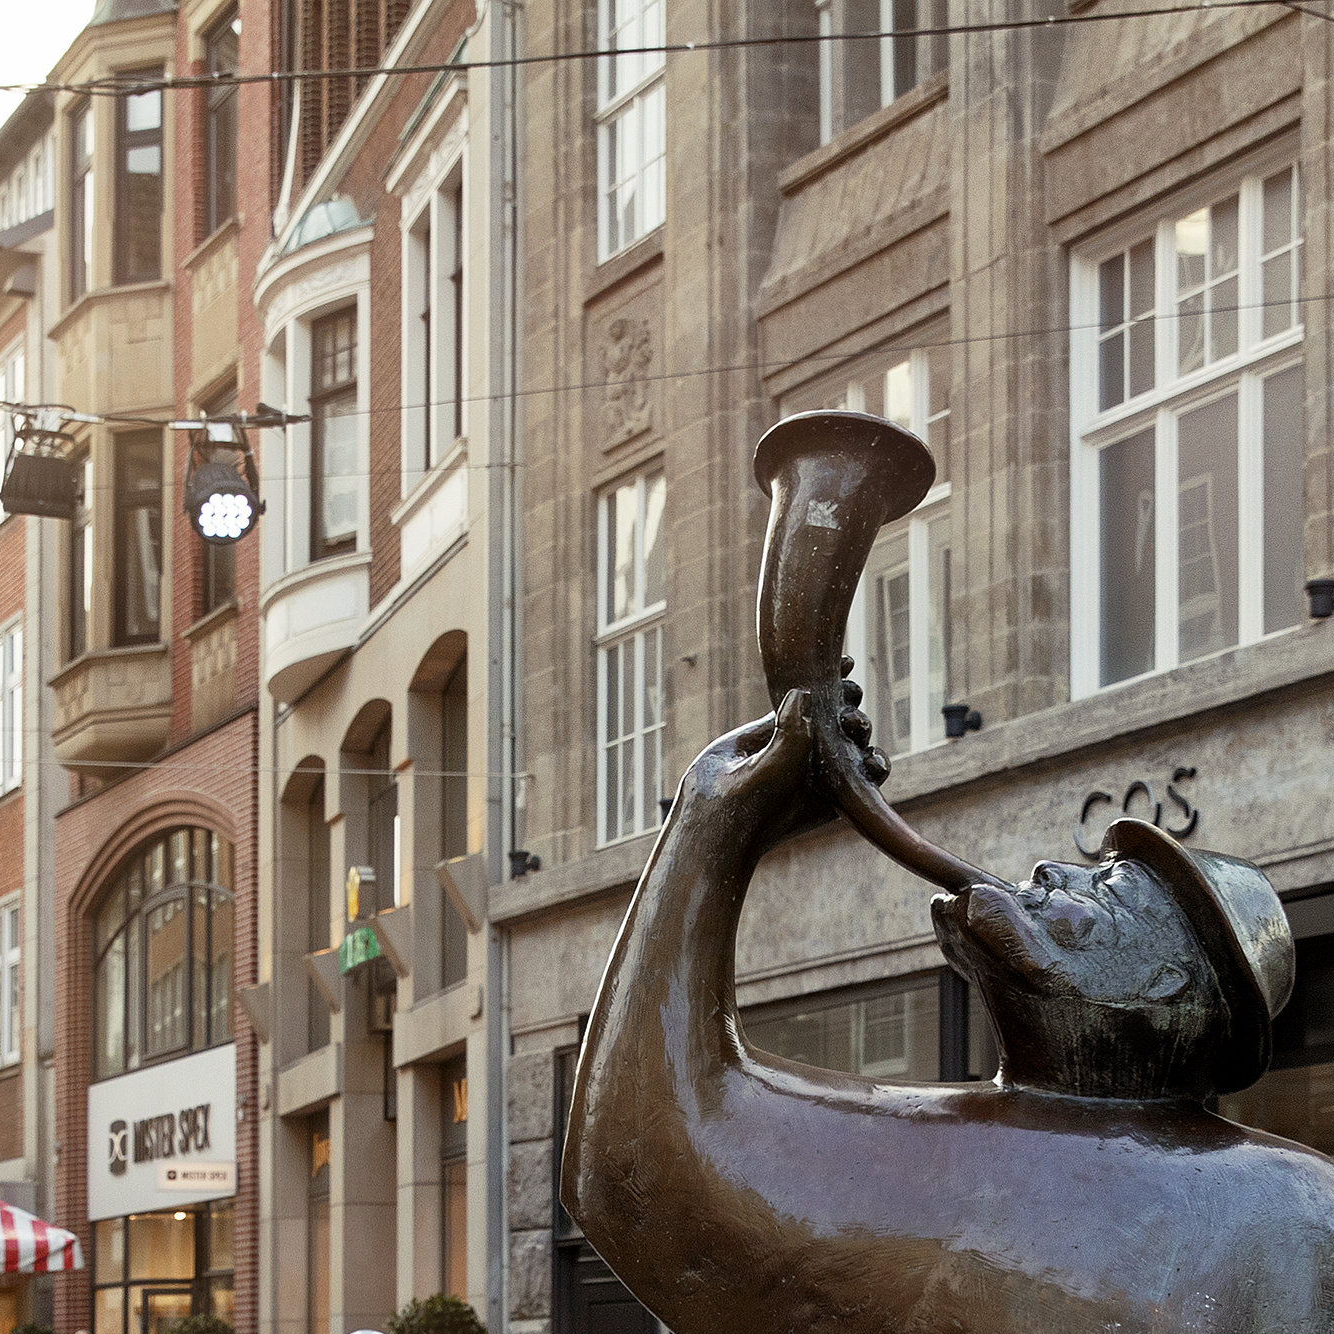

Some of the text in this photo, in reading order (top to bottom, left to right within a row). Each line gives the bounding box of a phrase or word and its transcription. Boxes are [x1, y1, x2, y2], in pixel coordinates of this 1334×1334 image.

[1073, 767, 1199, 859] COS
[133, 1103, 210, 1164] MISTER SPEX
